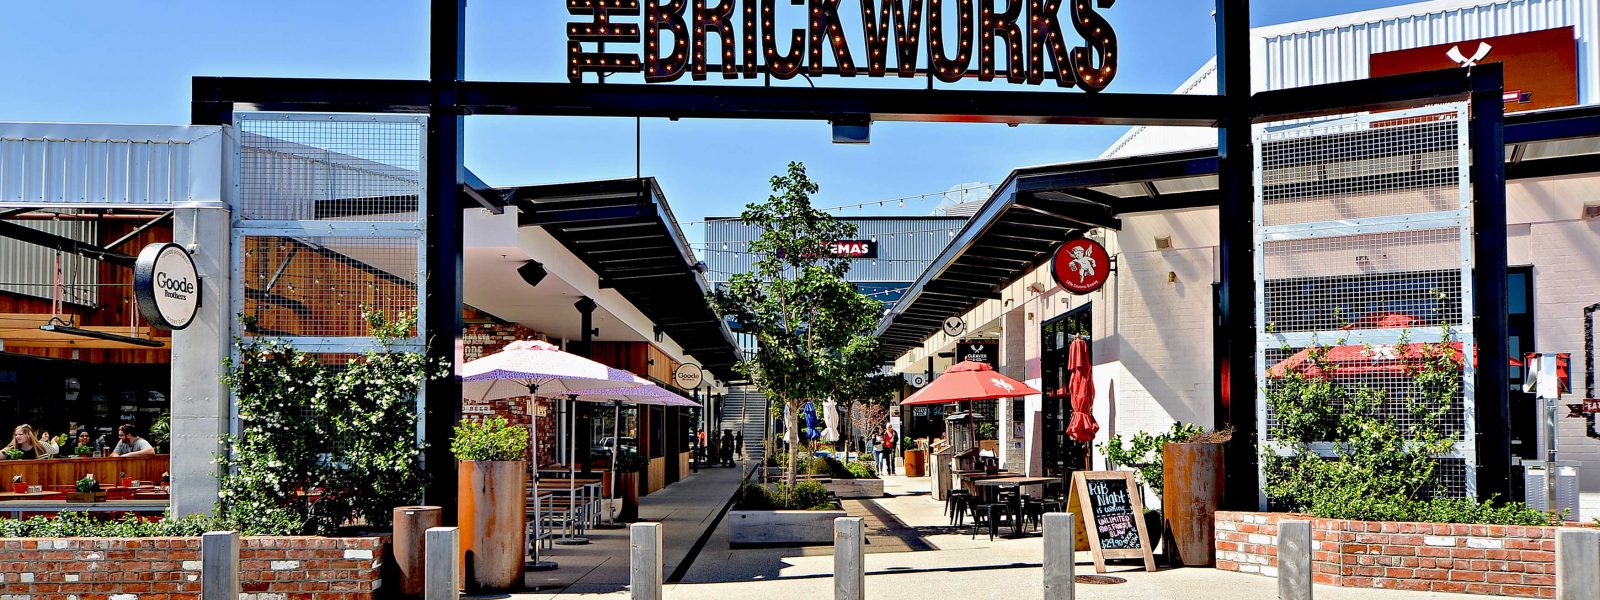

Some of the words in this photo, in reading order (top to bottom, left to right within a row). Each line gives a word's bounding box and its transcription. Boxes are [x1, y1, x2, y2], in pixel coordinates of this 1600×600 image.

[566, 0, 641, 83] TH
[644, 0, 1118, 93] BRICKWORKS
[157, 272, 193, 294] Goode
[164, 289, 187, 301] Brothers
[1097, 515, 1130, 525] UNLIMITED
[1109, 528, 1126, 538] SLAW
